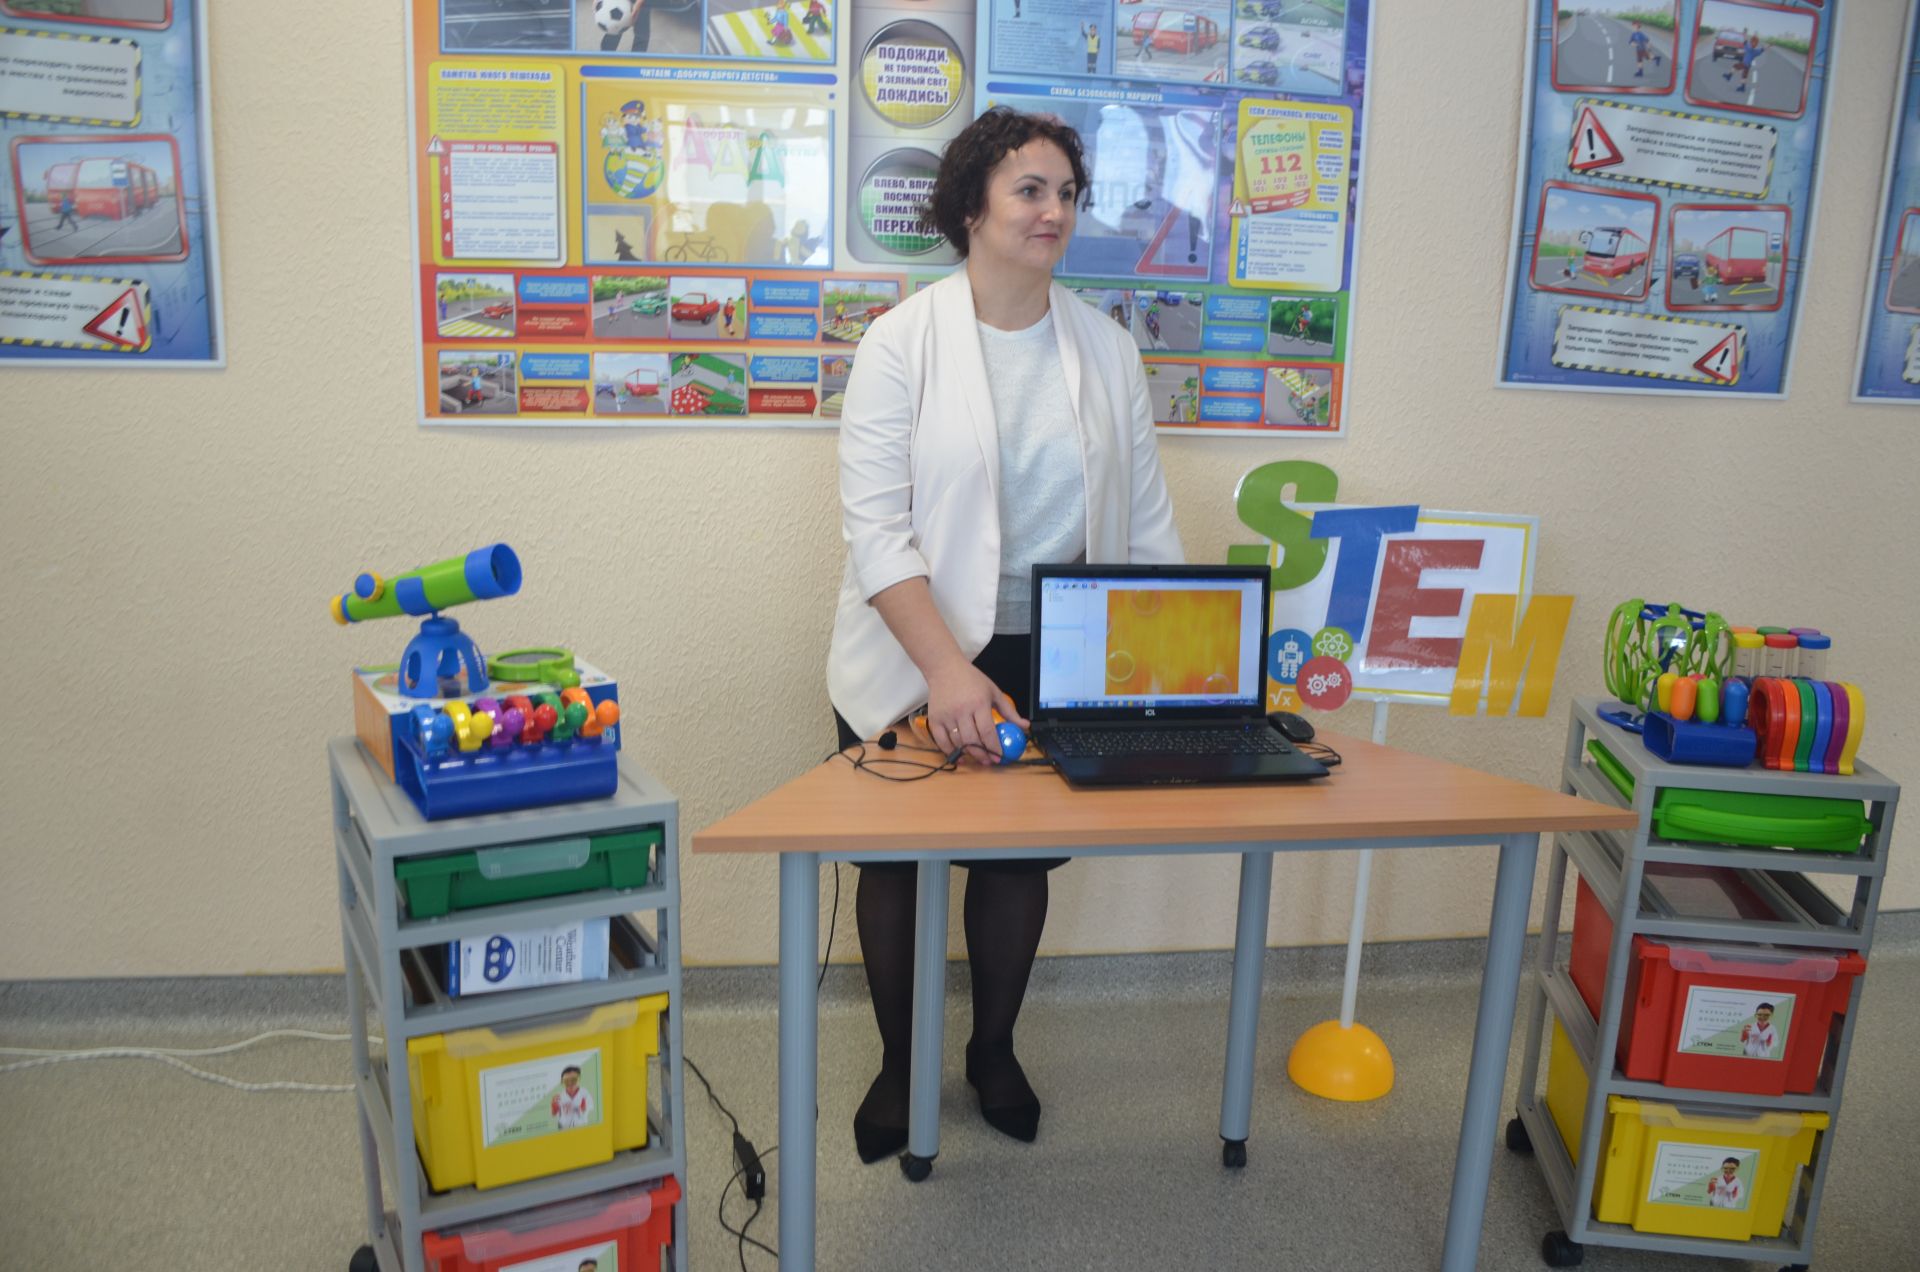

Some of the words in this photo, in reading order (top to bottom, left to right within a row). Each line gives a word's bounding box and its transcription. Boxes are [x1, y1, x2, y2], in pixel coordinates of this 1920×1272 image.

[878, 47, 948, 63] ПОДОЖДИ,
[640, 69, 671, 79] ЧИТАЕМ
[710, 70, 740, 81] ДОРОГУ
[884, 64, 894, 72] НЕ
[878, 75, 884, 83] И
[885, 75, 926, 86] ЗЕЛЕНЫЙ
[927, 78, 948, 86] СВЕТ
[877, 88, 948, 103] ДОЖДИСЬ!
[1051, 86, 1076, 97] СХЕМЫ
[1077, 88, 1124, 100] БЕЗОПАСНОГО
[1126, 91, 1163, 102] МАРШРУТА
[1250, 131, 1306, 146] ТЕЛЕФОНЫ
[1260, 153, 1302, 175] 112
[874, 178, 907, 189] ВЛЕВО,
[909, 179, 937, 190] ВПРА
[443, 192, 450, 203] 2
[883, 192, 930, 202] ПОСМОТР
[443, 209, 450, 220] 3
[873, 219, 938, 237] ПЕРЕХОД
[444, 232, 451, 242] 4
[1227, 460, 1575, 718] STEM
[555, 935, 564, 973] Center
[565, 928, 577, 974] Weather
